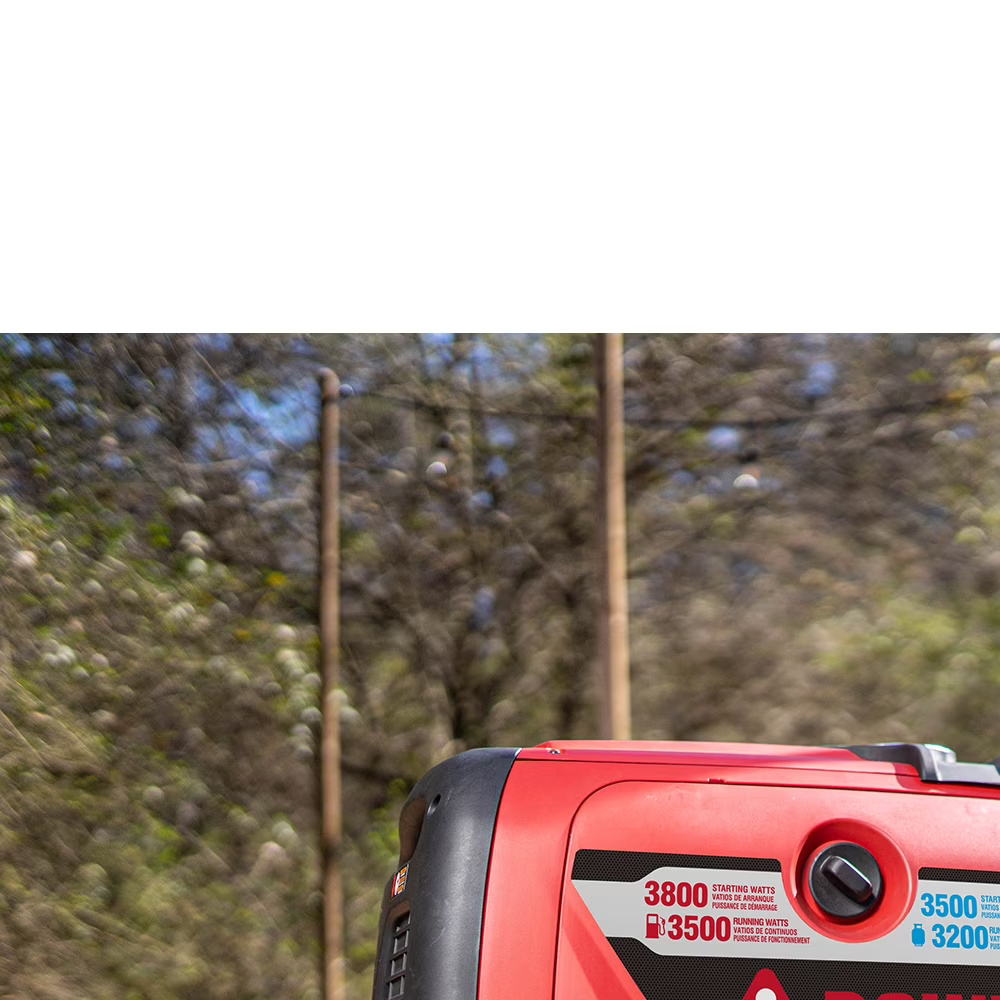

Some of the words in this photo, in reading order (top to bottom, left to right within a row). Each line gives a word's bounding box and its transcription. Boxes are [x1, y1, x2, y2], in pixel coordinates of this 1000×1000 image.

[644, 880, 709, 908] 3800
[712, 884, 749, 893] STARTING
[750, 886, 776, 895] WATTS
[743, 895, 774, 903] ARRANQUE
[712, 902, 740, 910] PUISSANCE
[921, 893, 978, 919] 3500
[733, 917, 764, 926] RUNNING
[765, 919, 789, 927] WATTS
[667, 914, 731, 942] 3500
[764, 928, 798, 936] CONTINUOS
[768, 936, 811, 944] FONCTIONNEMENT
[931, 923, 989, 950] 3200
